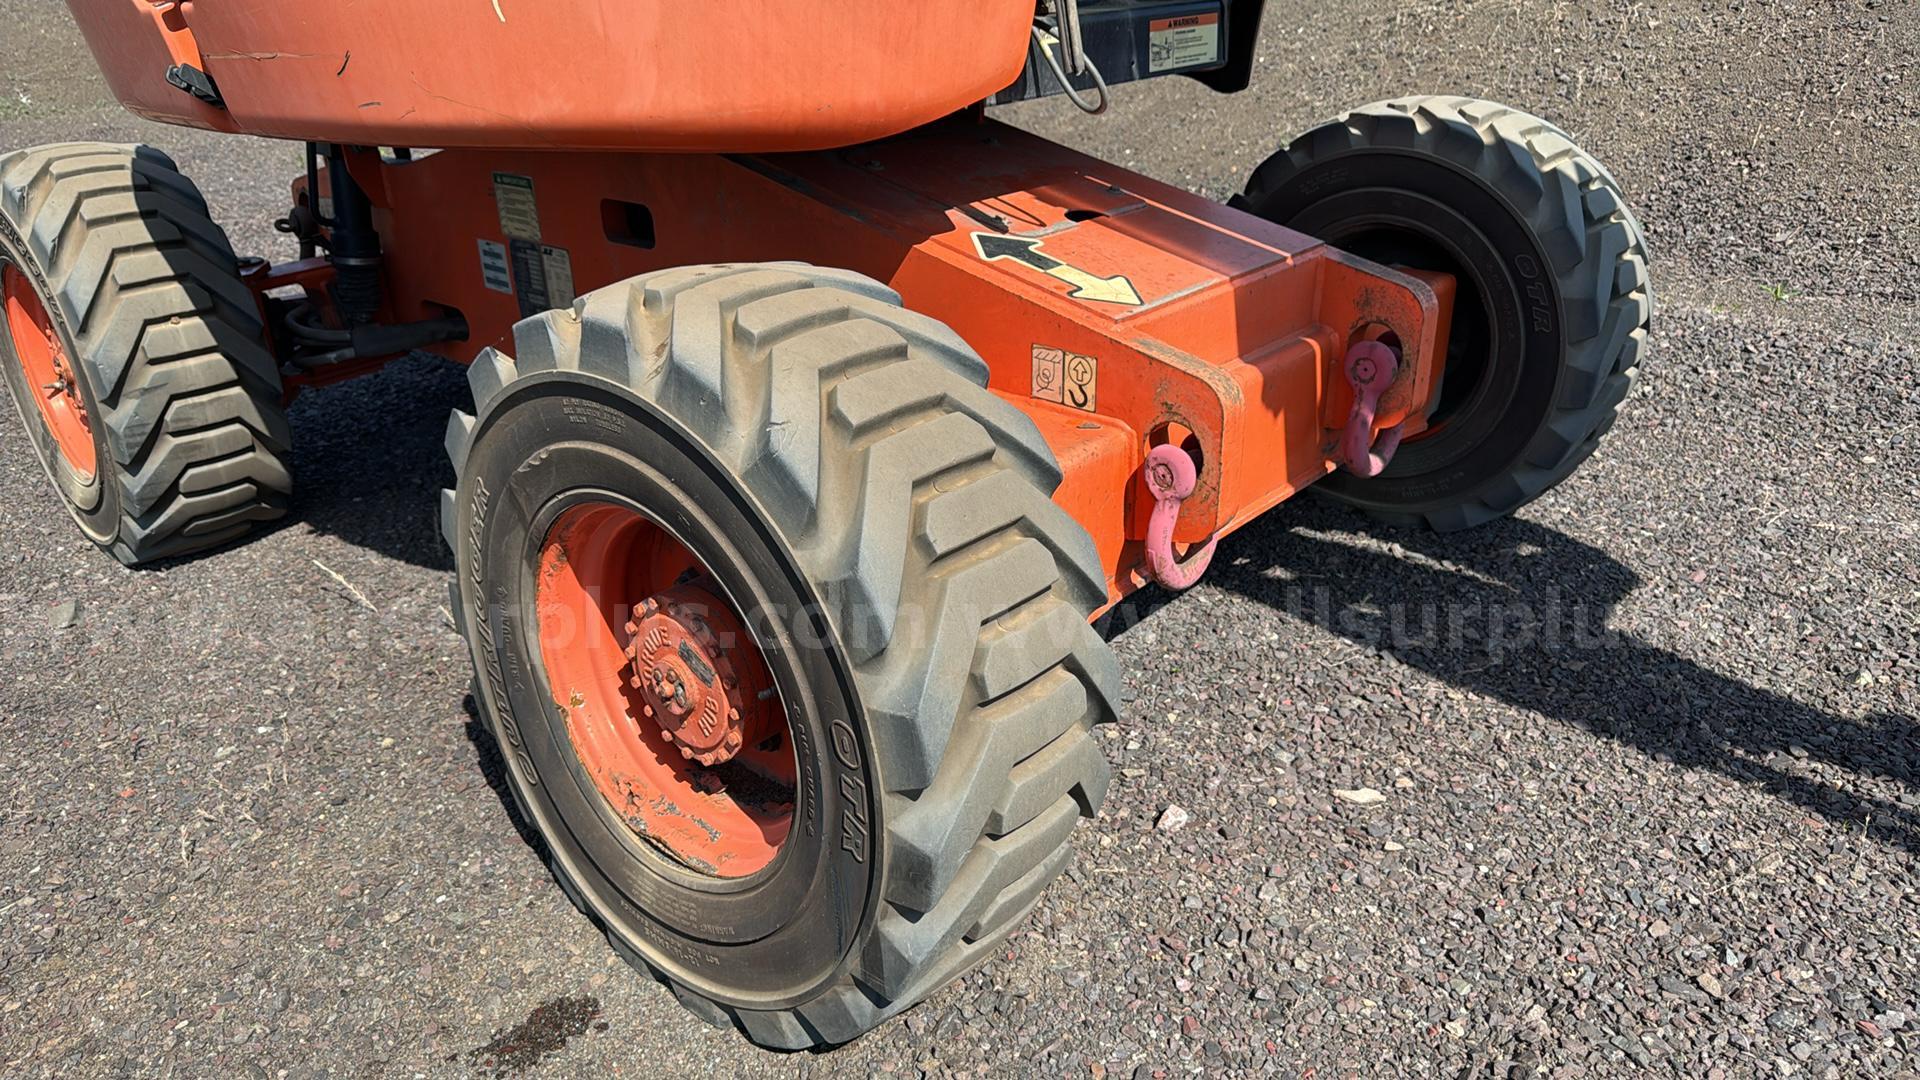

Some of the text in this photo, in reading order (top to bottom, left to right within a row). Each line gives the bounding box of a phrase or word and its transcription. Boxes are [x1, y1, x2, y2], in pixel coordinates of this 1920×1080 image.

[1173, 16, 1200, 28] WARNING
[1514, 253, 1552, 333] OTR
[469, 476, 538, 786] OUTRIGGER
[641, 625, 673, 690] ORQUE
[697, 695, 720, 739] HUB
[829, 718, 868, 863] OTR
